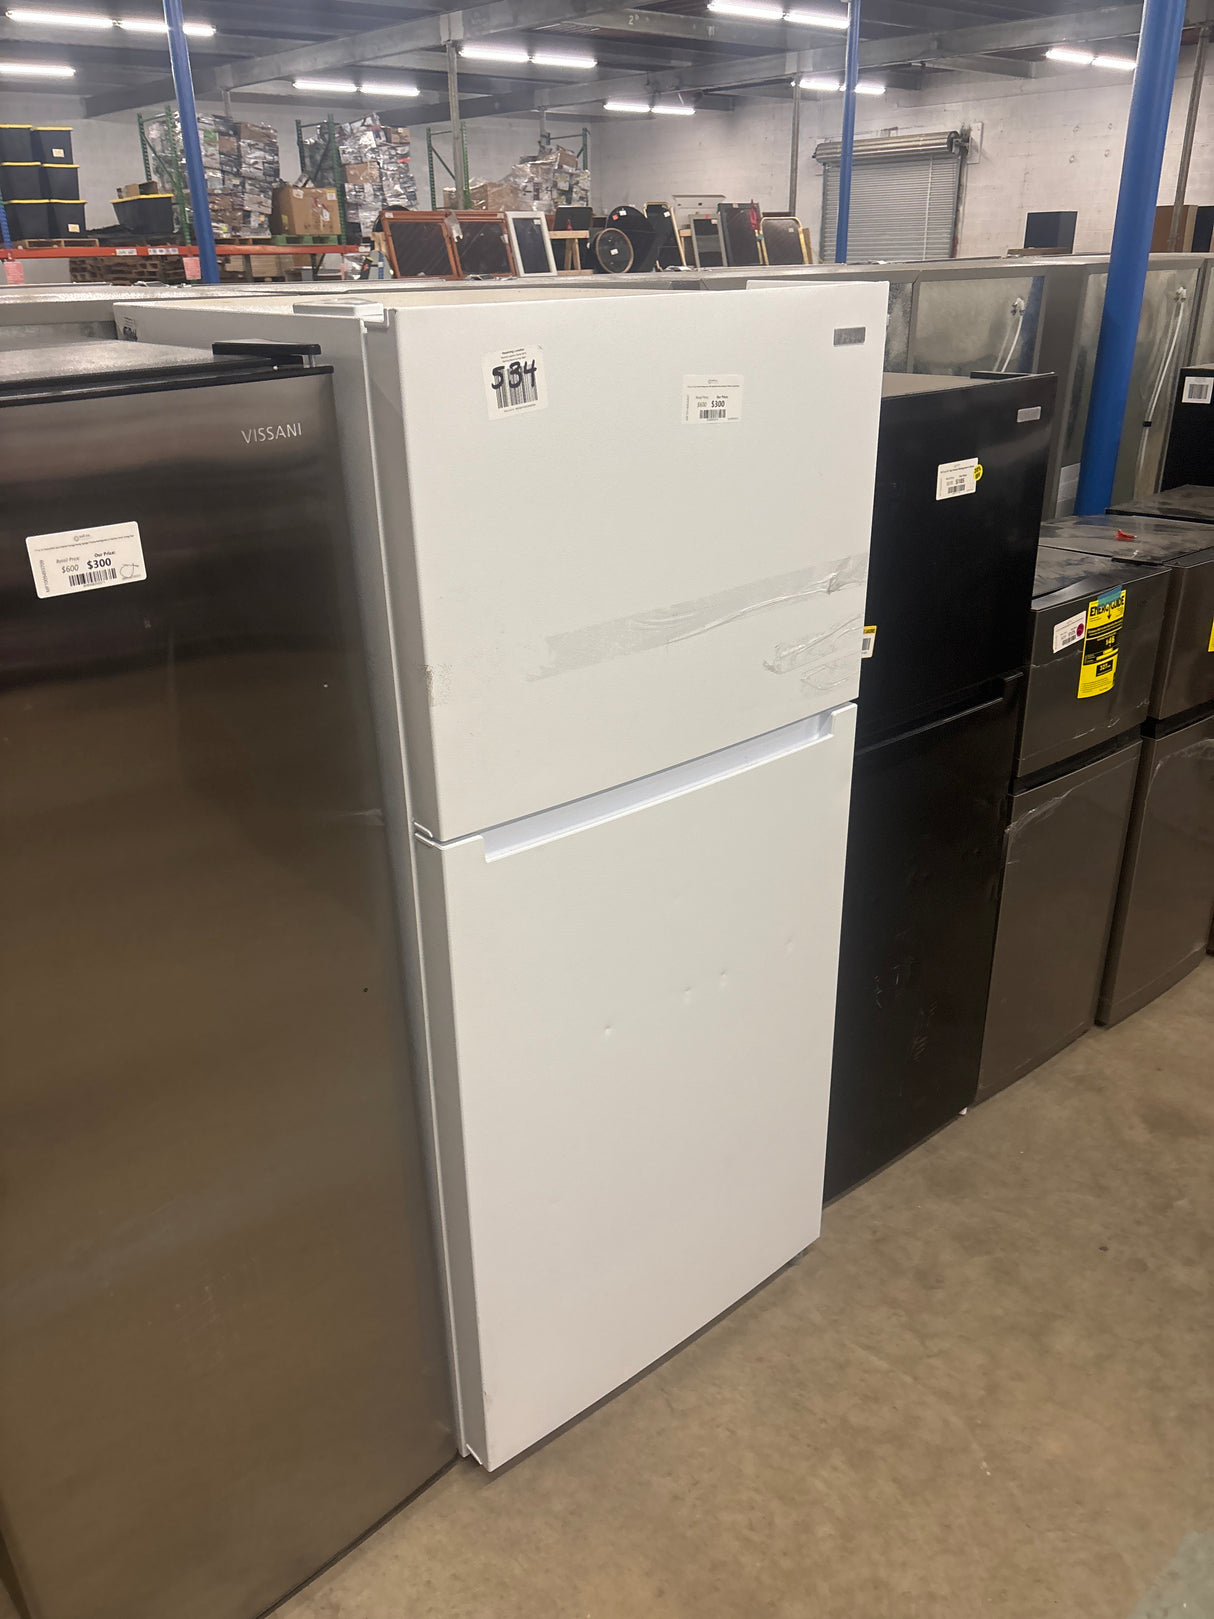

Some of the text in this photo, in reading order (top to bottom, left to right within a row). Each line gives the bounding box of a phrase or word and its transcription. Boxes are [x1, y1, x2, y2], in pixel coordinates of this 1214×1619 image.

[711, 400, 725, 408] $300
[241, 422, 302, 444] VISSANI
[61, 557, 112, 574] $600 $300
